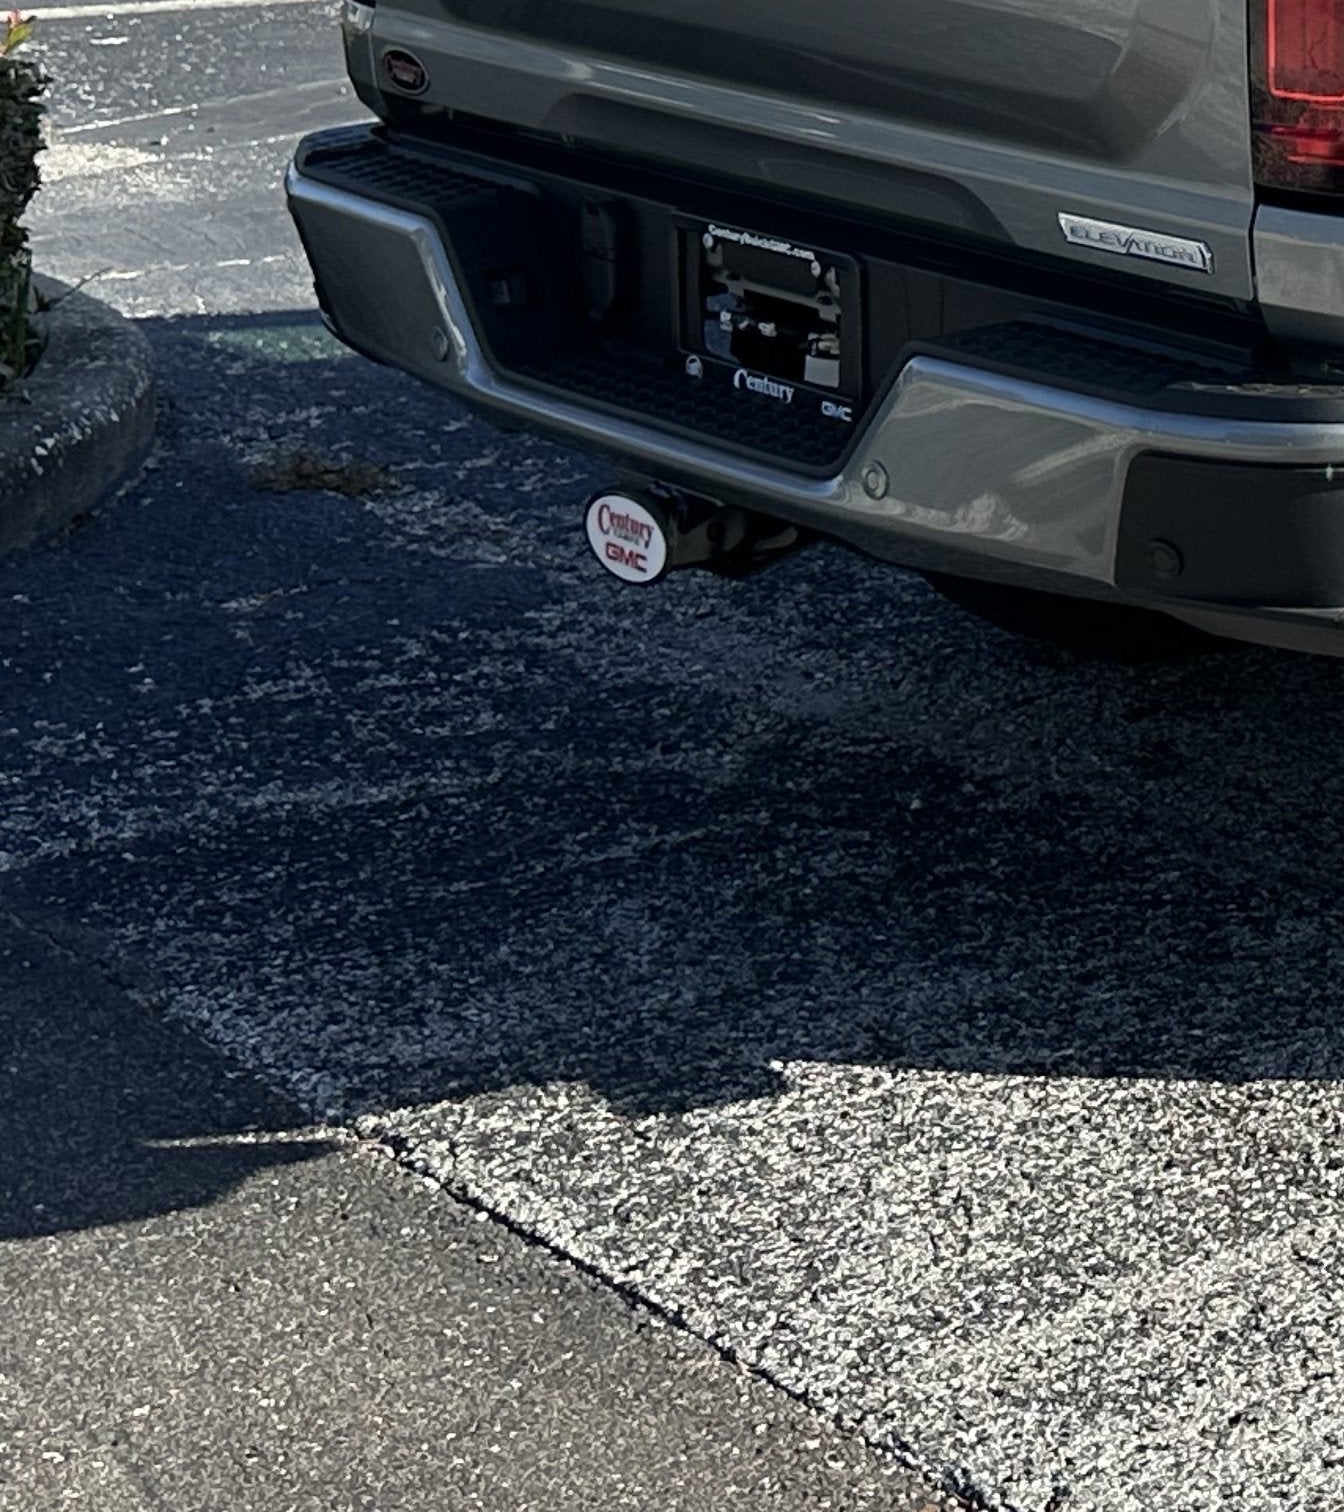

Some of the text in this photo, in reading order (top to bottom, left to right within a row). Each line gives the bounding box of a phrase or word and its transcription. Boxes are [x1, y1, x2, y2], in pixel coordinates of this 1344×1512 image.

[733, 368, 794, 403] Century
[598, 503, 653, 549] Century
[605, 541, 648, 573] GMC
